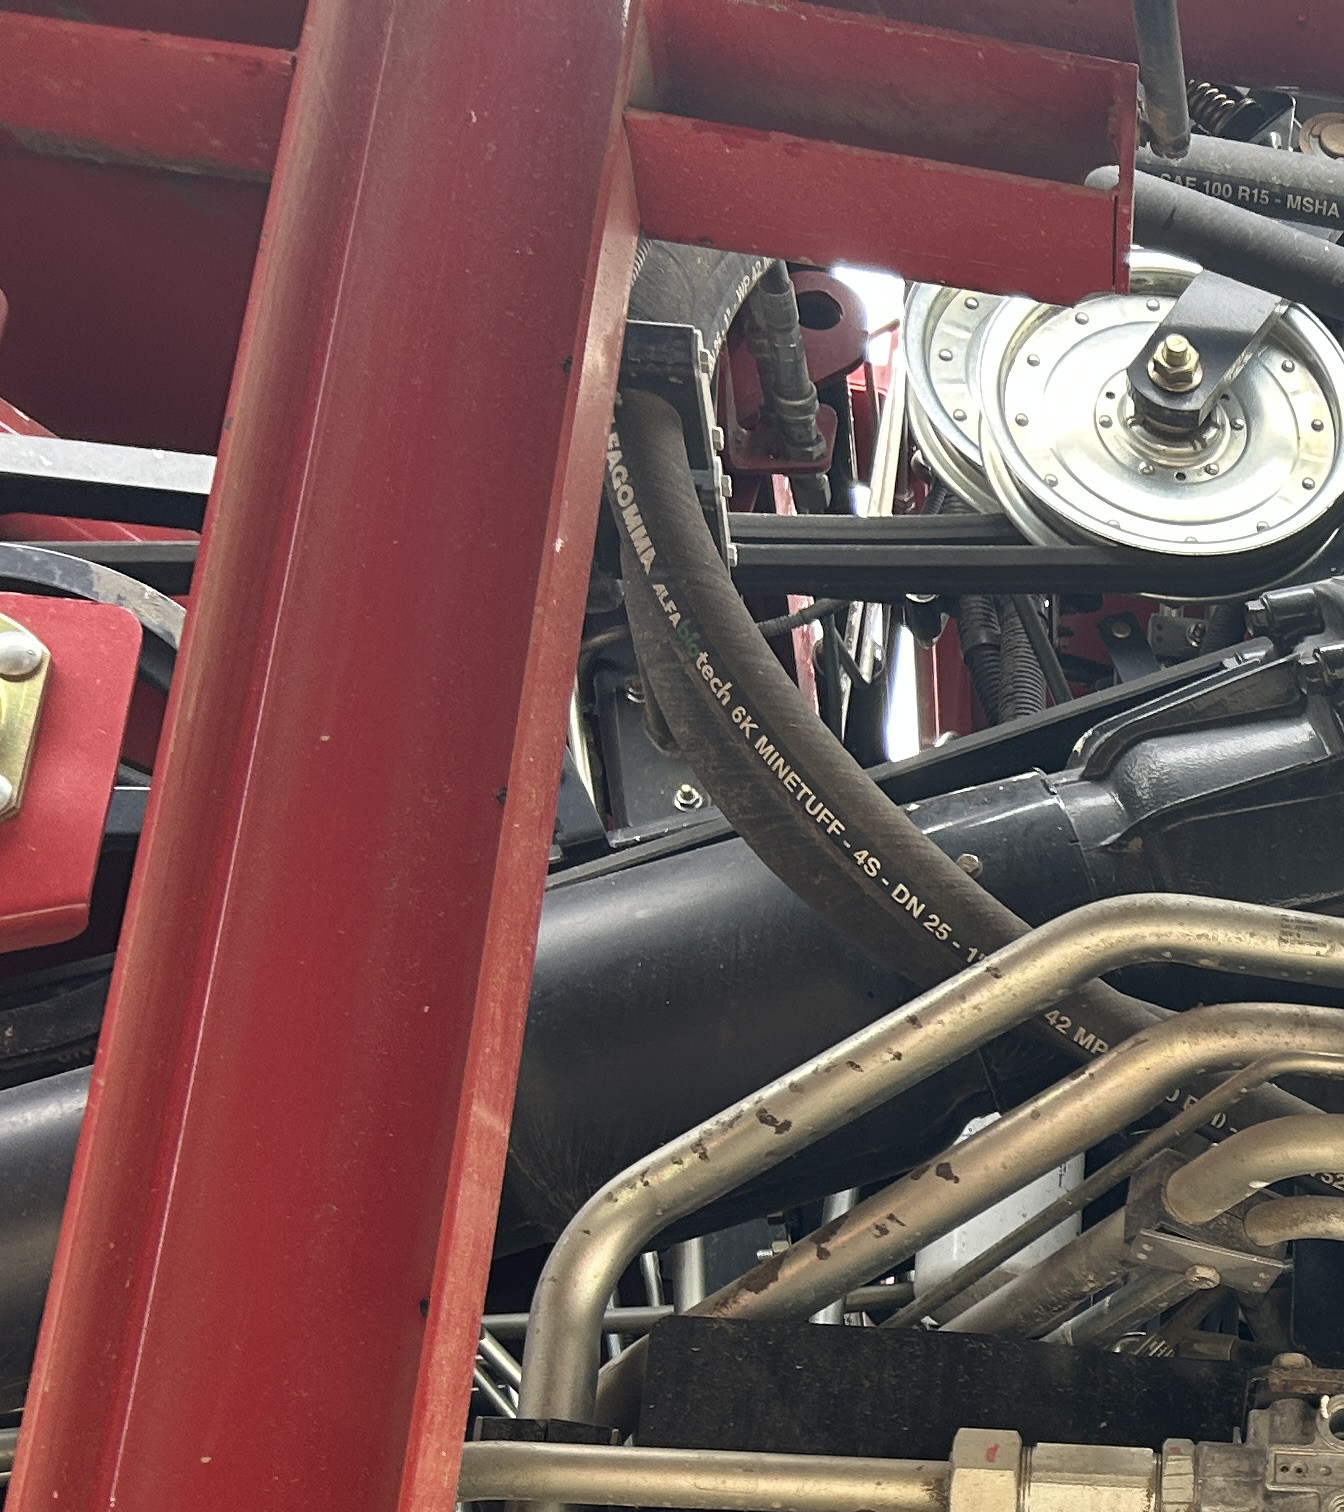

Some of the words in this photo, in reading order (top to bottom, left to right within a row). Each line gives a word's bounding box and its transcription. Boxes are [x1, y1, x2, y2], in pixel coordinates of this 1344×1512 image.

[1202, 180, 1233, 200] 100
[1237, 186, 1270, 206] R15
[1286, 195, 1341, 221] MSHA
[731, 705, 759, 740] 6K
[754, 734, 846, 836] MINETUFF
[853, 849, 882, 878] 4S
[890, 883, 925, 919] DN
[922, 914, 952, 942] 25
[1044, 1009, 1072, 1034] 42
